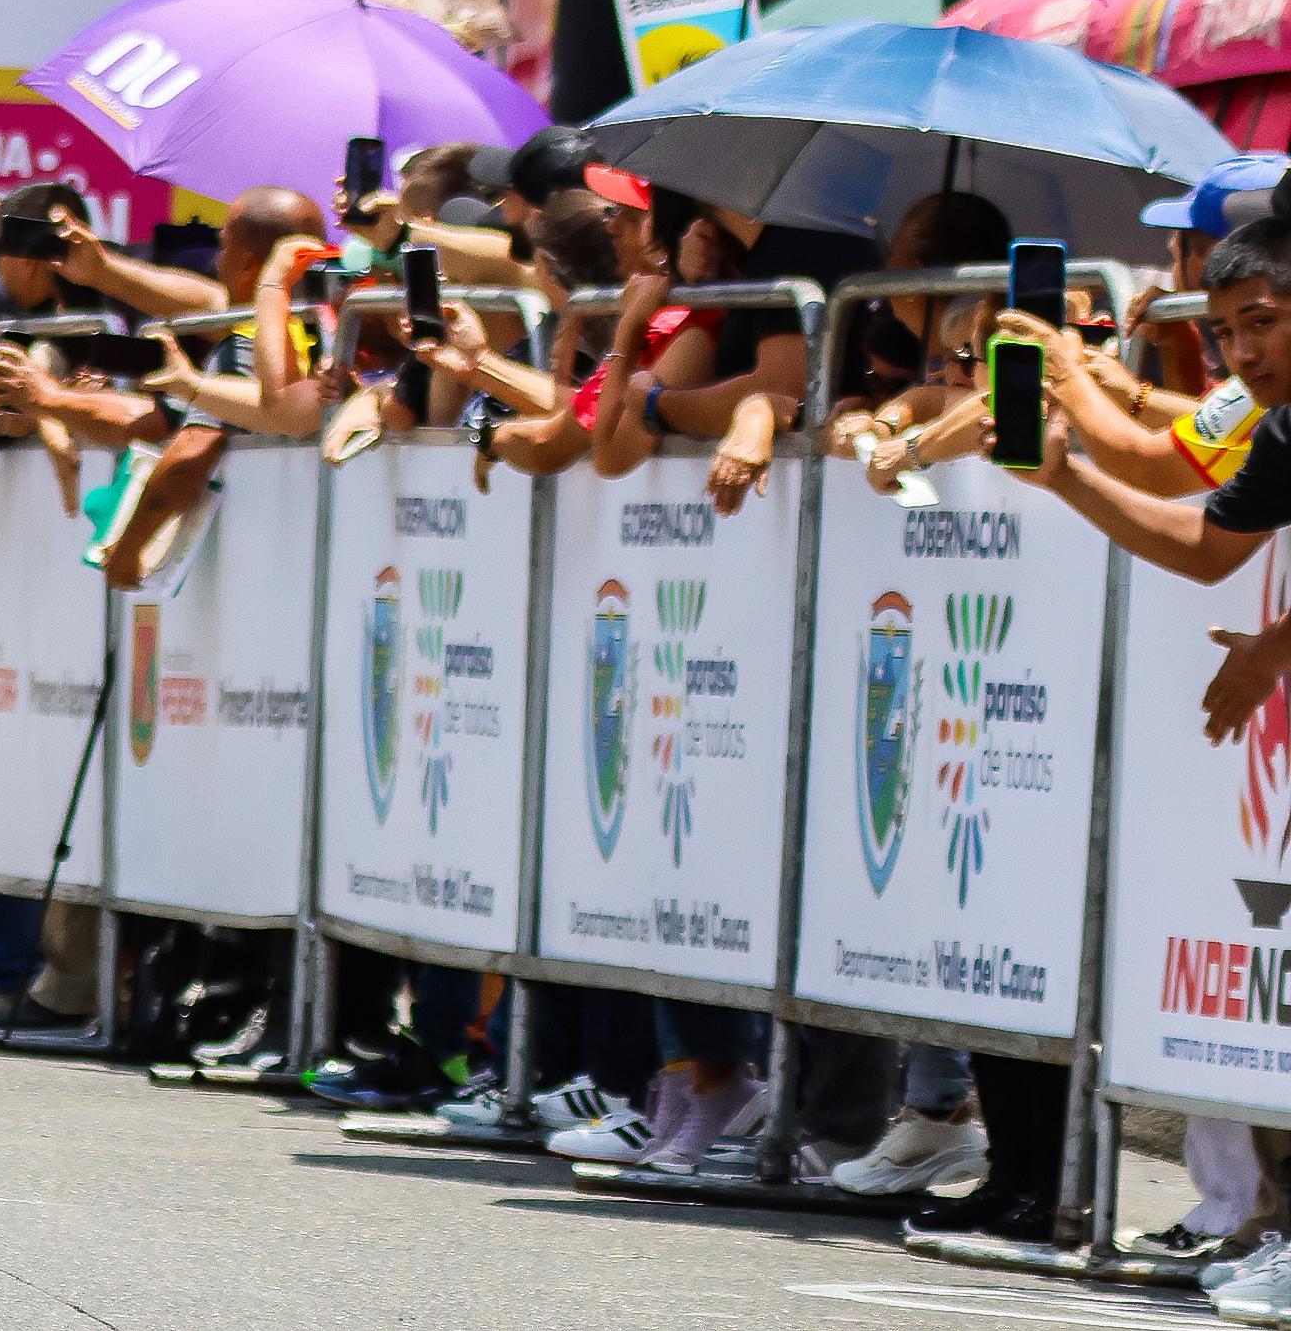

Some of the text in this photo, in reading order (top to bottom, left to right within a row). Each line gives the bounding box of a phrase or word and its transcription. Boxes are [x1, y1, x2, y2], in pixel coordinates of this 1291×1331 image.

[85, 32, 203, 110] nu
[904, 498, 1021, 559] GOBERNACIÓN
[934, 939, 968, 994] Valle
